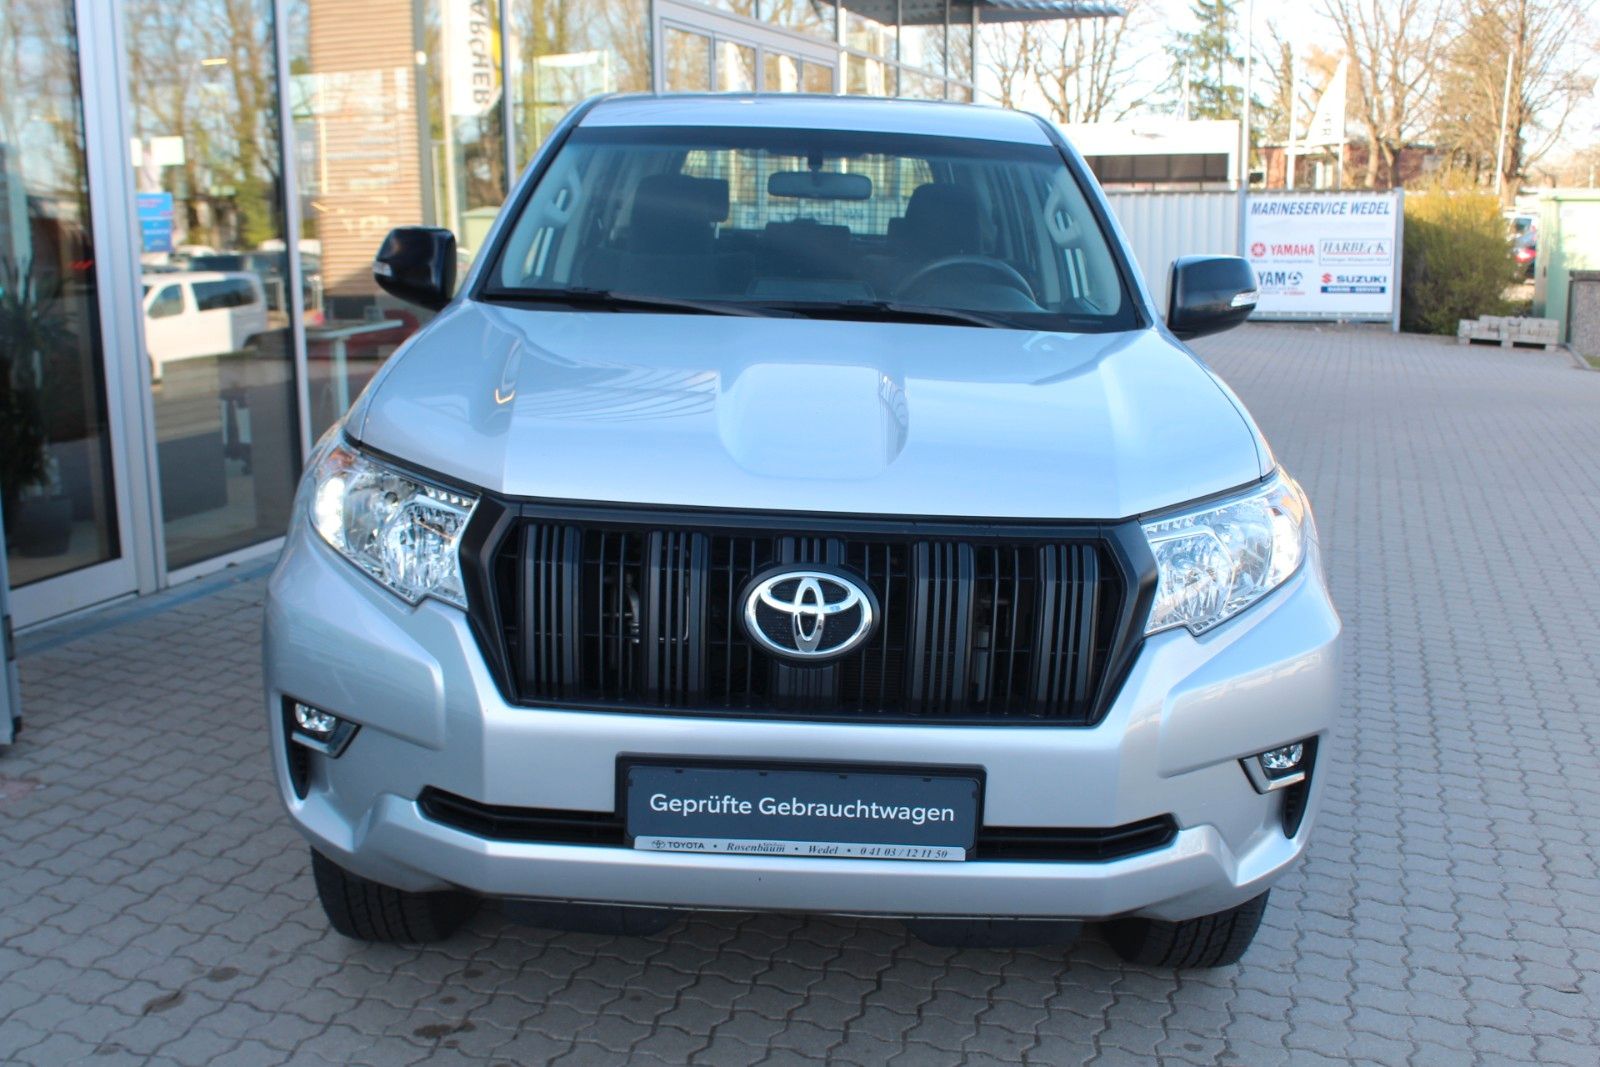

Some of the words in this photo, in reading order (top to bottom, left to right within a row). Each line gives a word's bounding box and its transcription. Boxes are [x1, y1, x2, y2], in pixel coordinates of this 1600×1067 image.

[1251, 201, 1347, 215] MARINESERVICE
[1350, 201, 1390, 215] WEDEL
[1270, 244, 1315, 255] YAMAHA
[1336, 274, 1387, 284] SUZUKI
[650, 793, 752, 816] Geprüfte
[758, 797, 955, 825] Gebrauchtwagen
[668, 841, 705, 849] TOYOTA
[726, 842, 786, 853] Rosenbaum
[808, 845, 839, 855] Wedel
